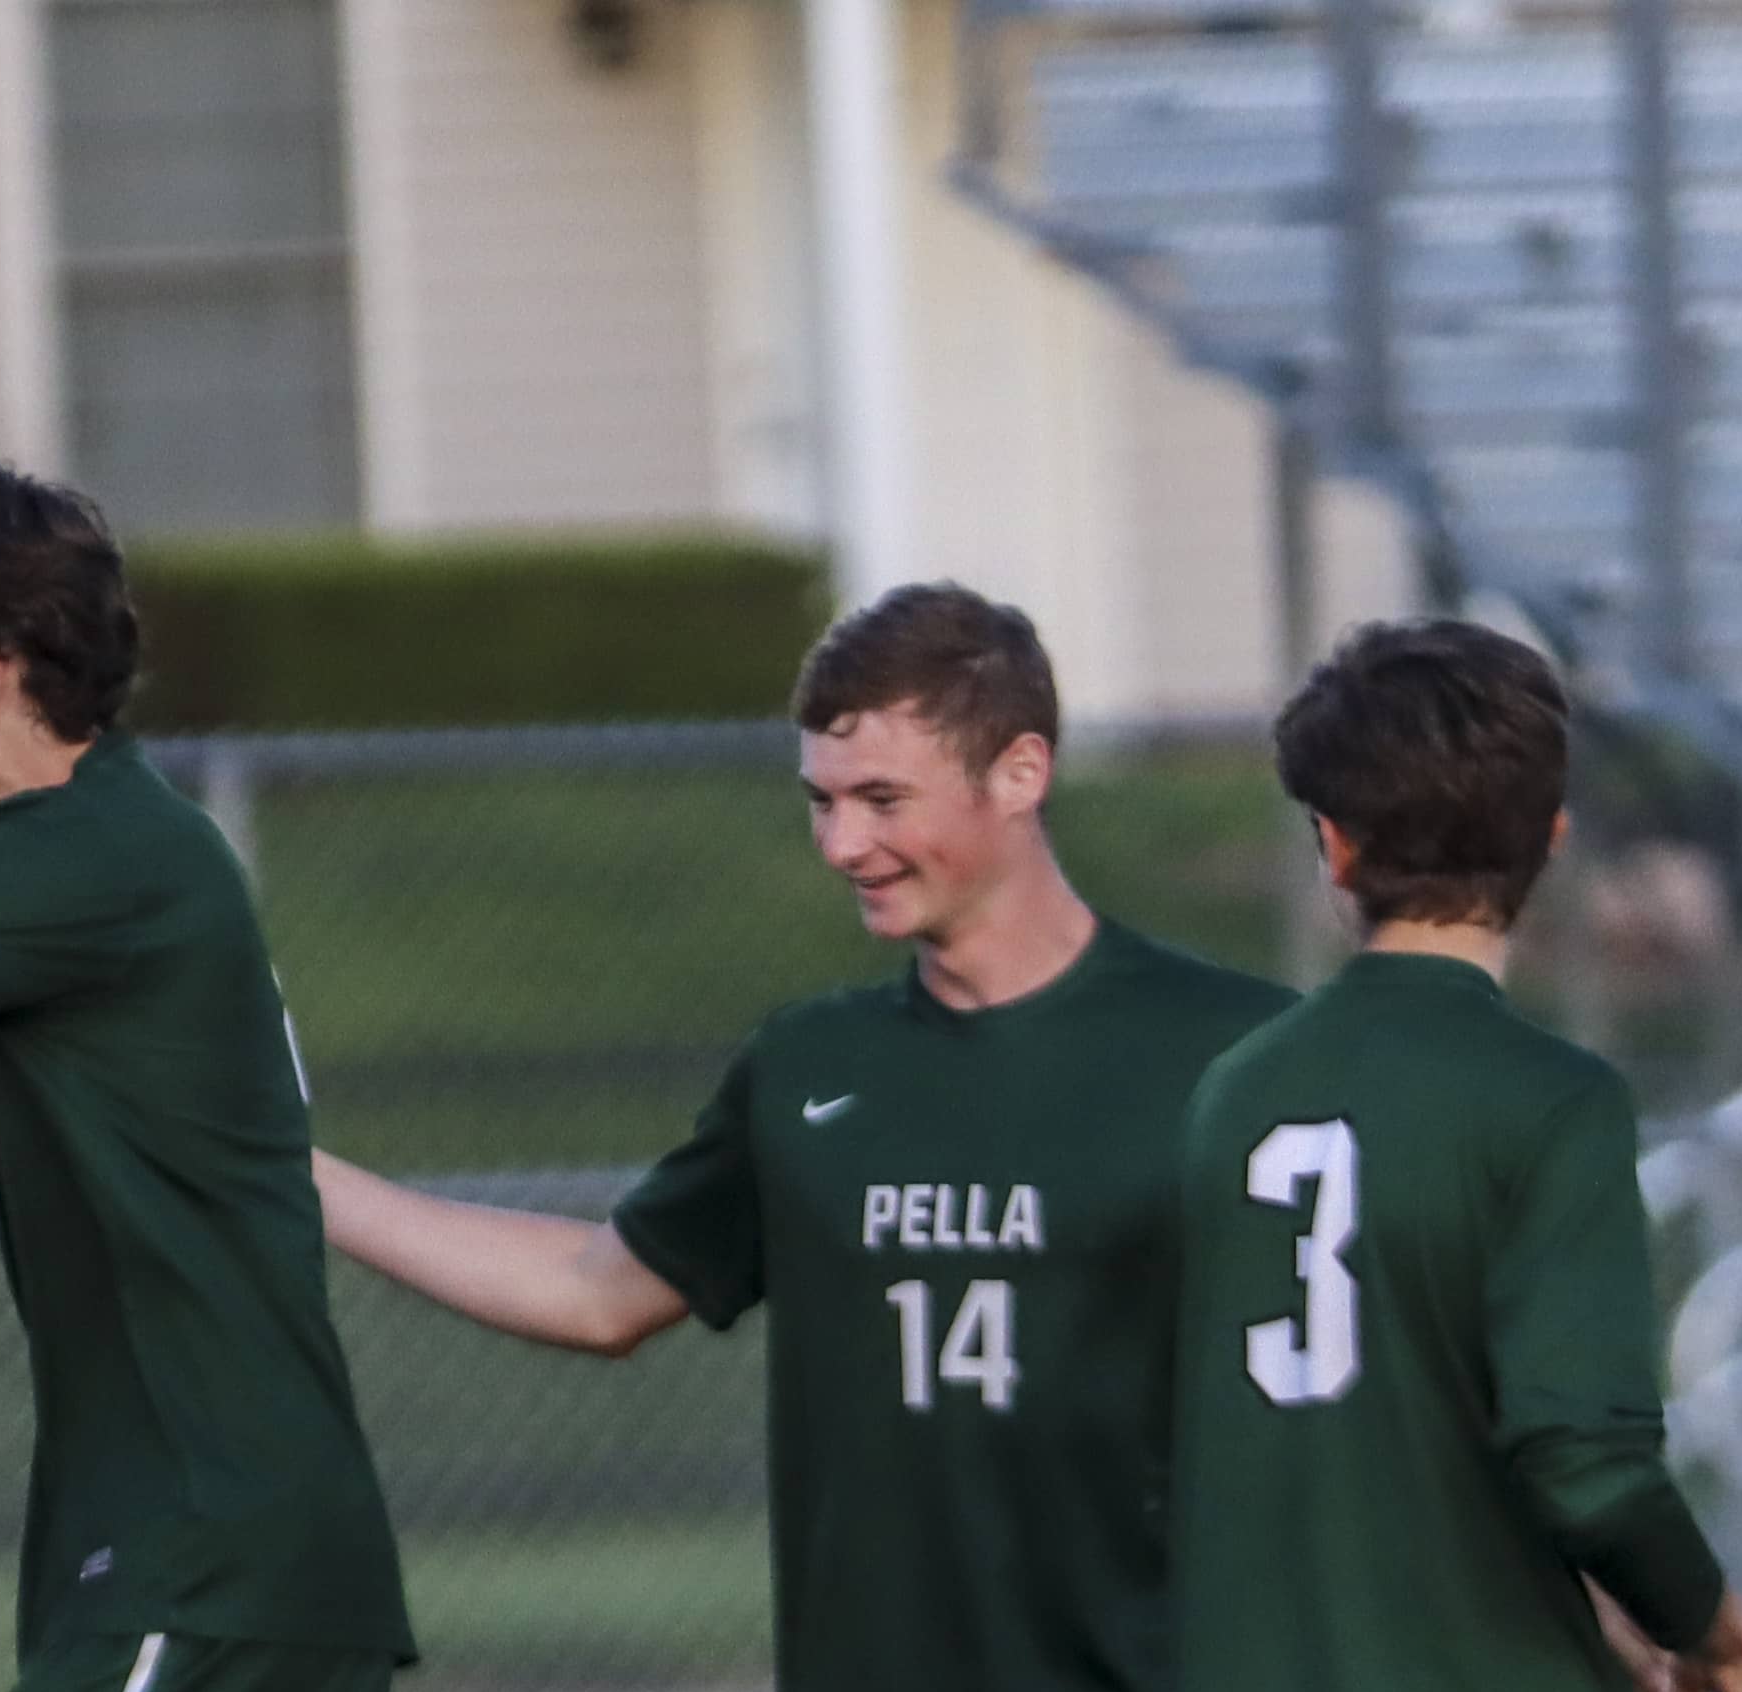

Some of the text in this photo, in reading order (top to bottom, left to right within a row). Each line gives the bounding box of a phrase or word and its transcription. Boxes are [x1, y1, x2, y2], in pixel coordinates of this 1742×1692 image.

[862, 1183, 1043, 1250] PELLA
[1246, 1118, 1358, 1405] 3
[886, 1279, 1017, 1411] 14
